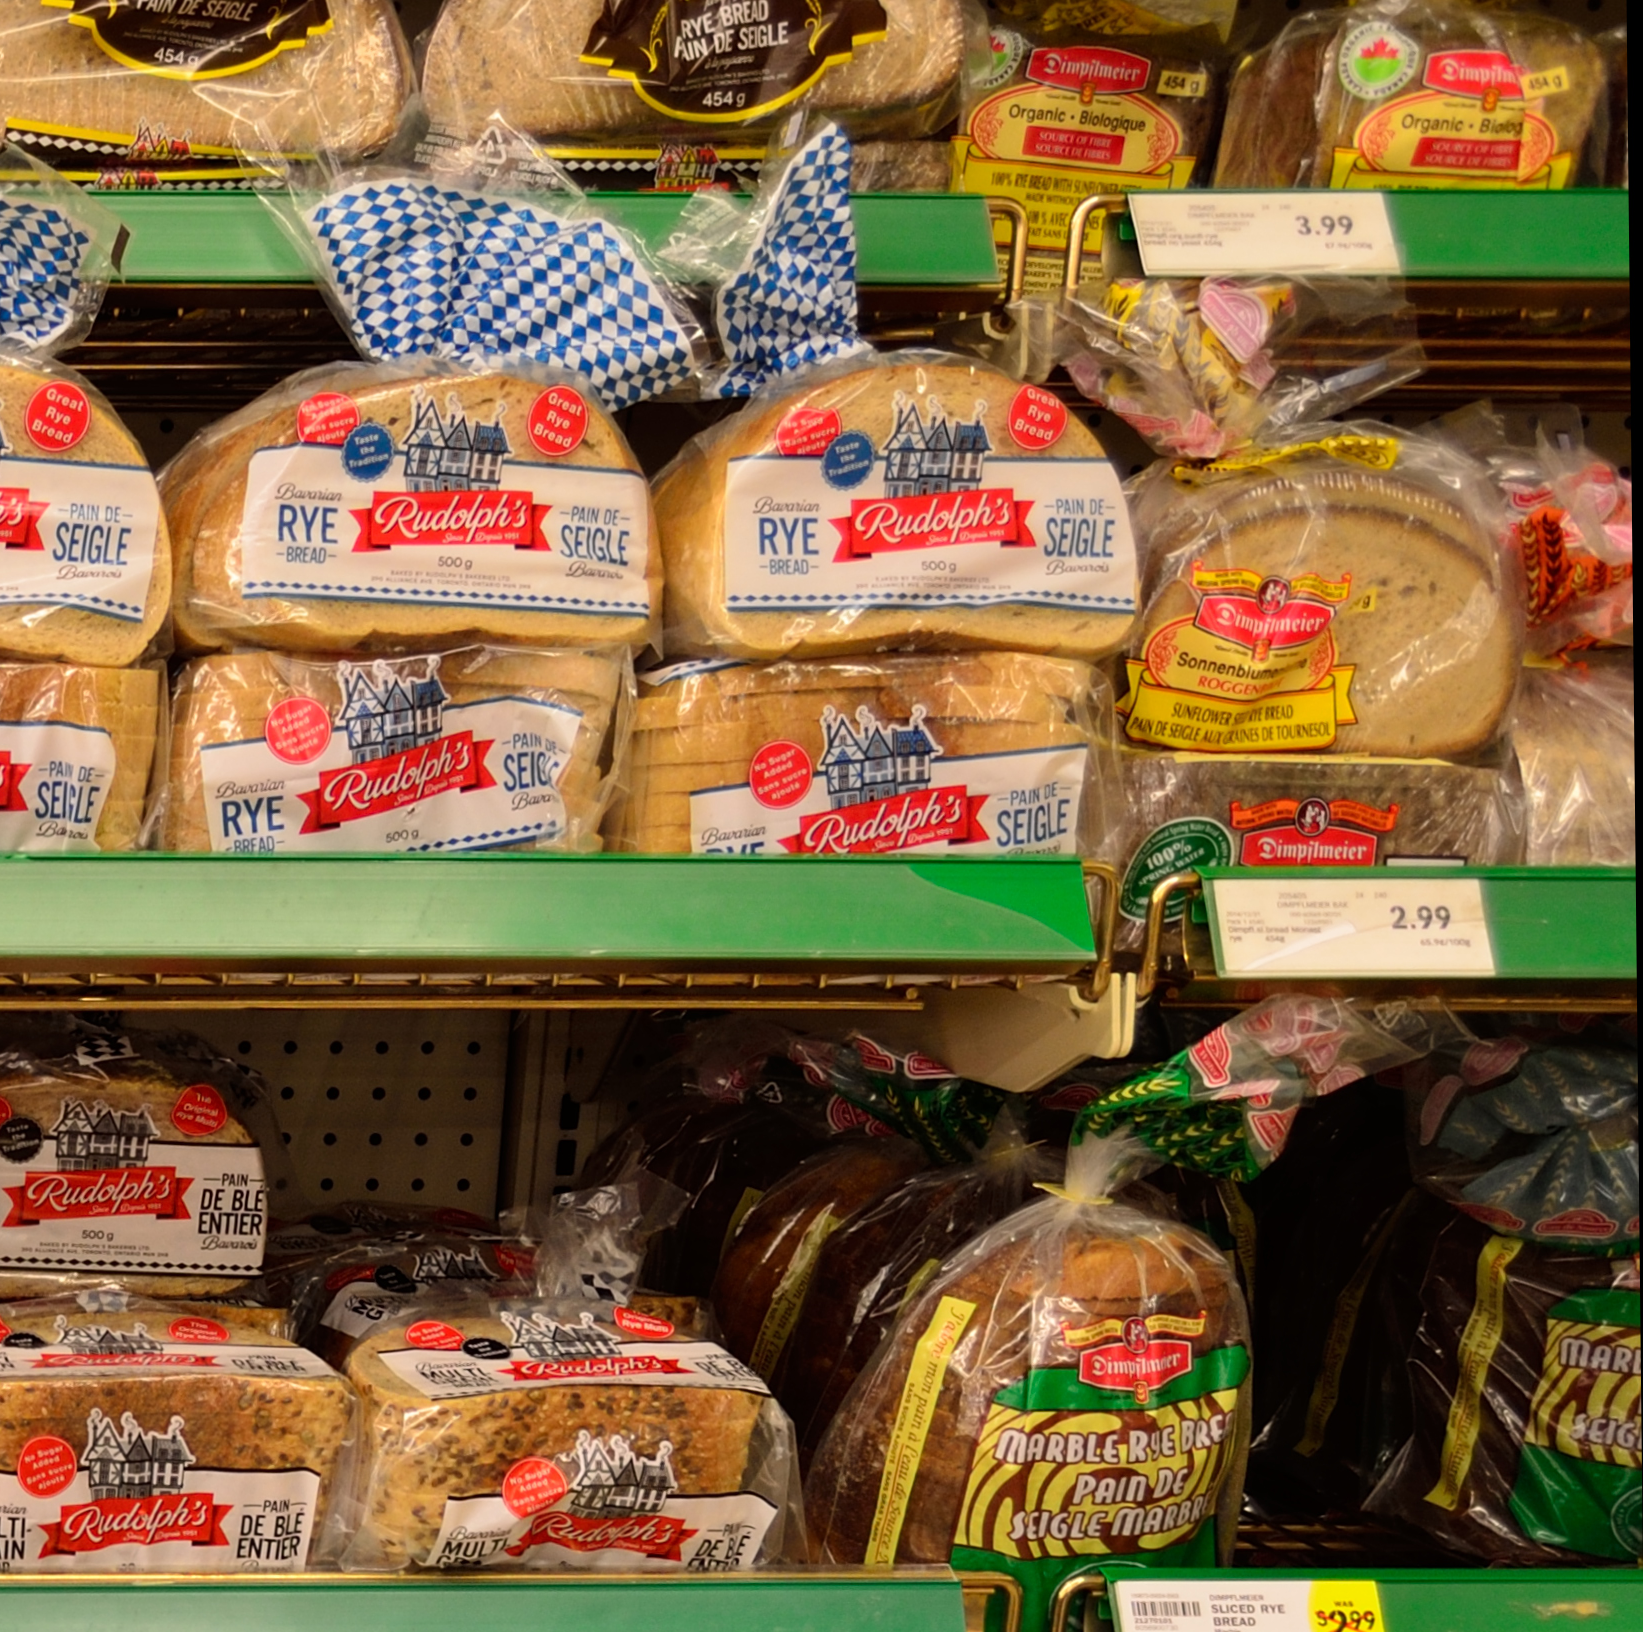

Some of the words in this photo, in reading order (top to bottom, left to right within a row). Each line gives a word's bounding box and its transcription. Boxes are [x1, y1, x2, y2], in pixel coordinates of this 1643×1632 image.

[702, 91, 732, 109] 454
[736, 93, 746, 109] g
[1008, 103, 1066, 124] Organic
[1079, 112, 1146, 134] Biologique
[1295, 215, 1353, 236] 3.99
[545, 391, 584, 414] Great
[545, 410, 573, 429] Rye
[533, 427, 579, 448] Bread
[275, 482, 342, 504] Bavarian
[277, 505, 338, 544] RYE
[374, 497, 529, 541] Rudolph's
[570, 506, 599, 524] PAIN
[602, 508, 619, 525] DE
[854, 492, 1013, 548] Rudolph's
[560, 525, 629, 565] SEIGLE
[1044, 516, 1113, 559] SEIGLE
[286, 546, 327, 564] BREAD
[437, 556, 460, 569] 500
[463, 559, 471, 571] g
[1276, 721, 1331, 739] TOURNESOL
[1258, 838, 1367, 863] Dimpflmeier
[1389, 906, 1451, 929] 2.99
[26, 1170, 172, 1215] Rudolph's
[995, 1424, 1119, 1464] MARBLE
[1073, 1474, 1144, 1507] PAIN
[1153, 1468, 1186, 1498] DE
[1010, 1505, 1104, 1541] SEIGLE
[1211, 1604, 1255, 1614] SLICED
[1261, 1604, 1285, 1614] RYE
[1213, 1618, 1256, 1626] BREAD
